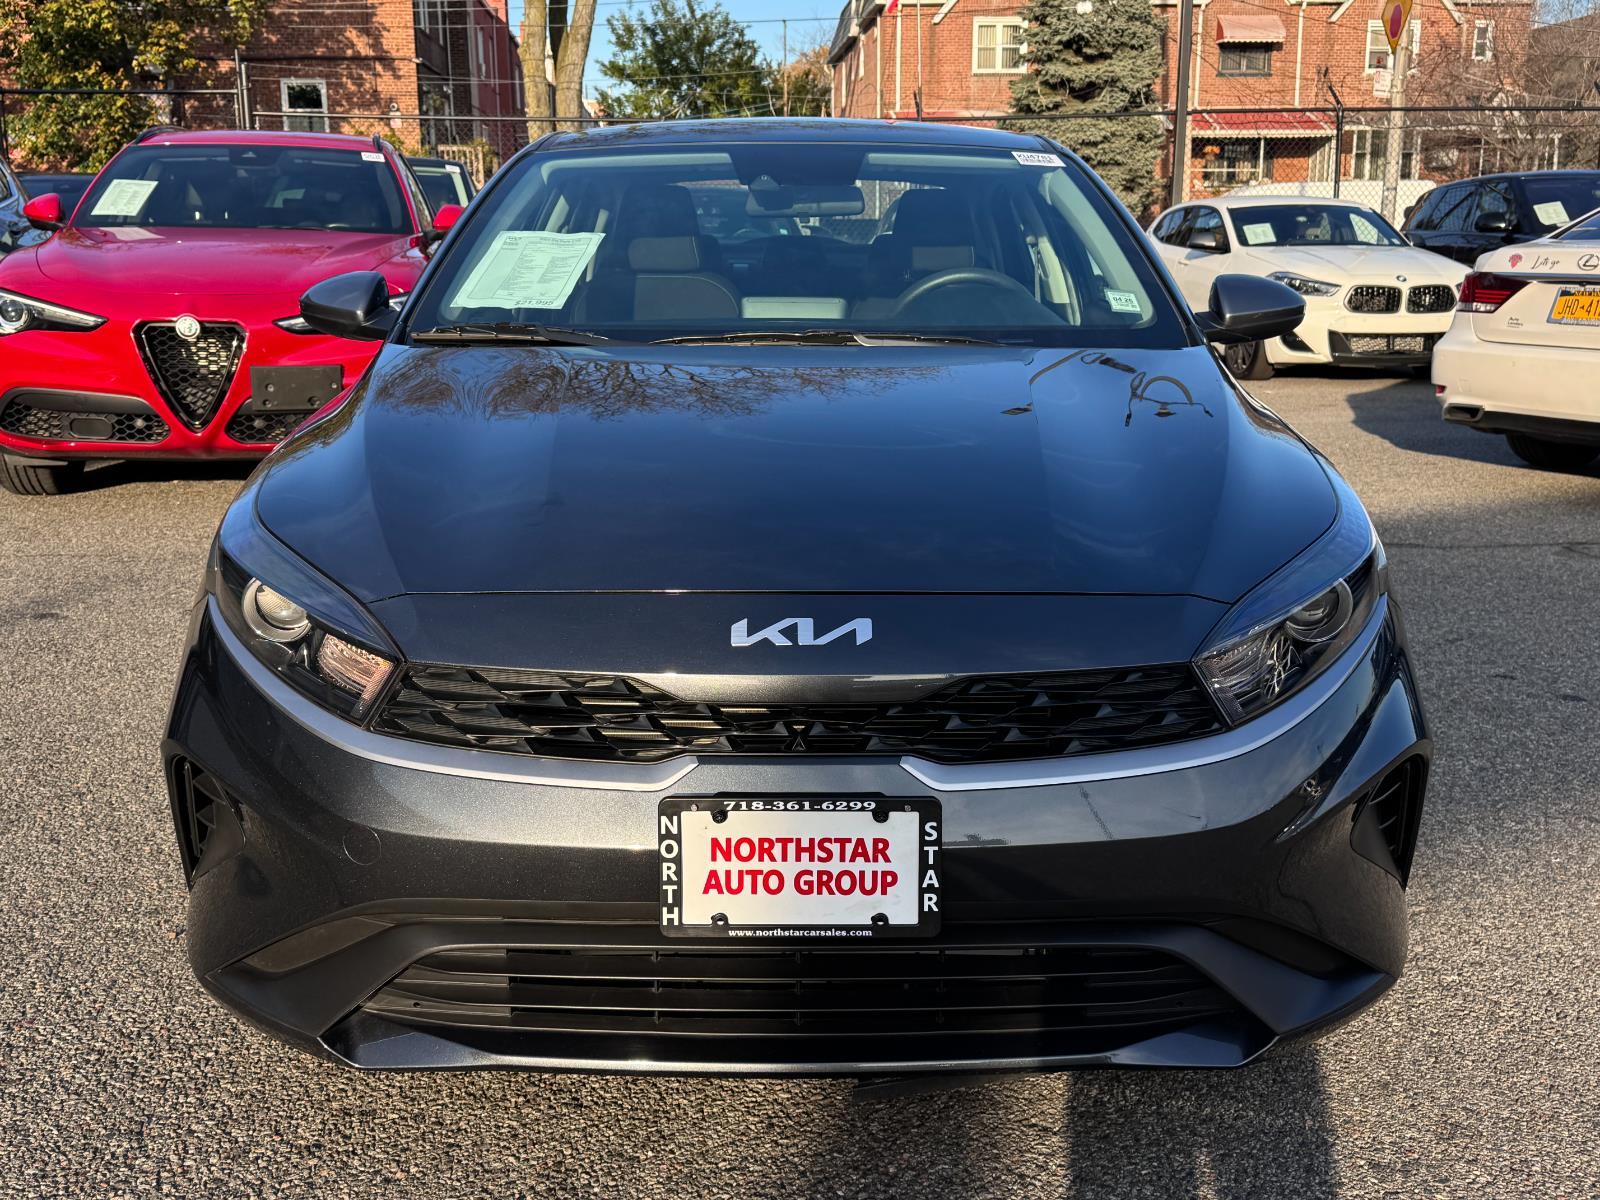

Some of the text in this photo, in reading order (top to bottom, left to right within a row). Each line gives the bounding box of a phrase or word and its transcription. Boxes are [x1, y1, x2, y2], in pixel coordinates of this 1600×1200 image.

[723, 801, 877, 811] 718-361-6299
[710, 837, 892, 863] NORTHSTAR
[659, 815, 679, 926] NORTH
[921, 821, 940, 912] STAR
[702, 869, 899, 896] AUTO GROUP
[728, 928, 873, 938] www.northstarcarsales.com
